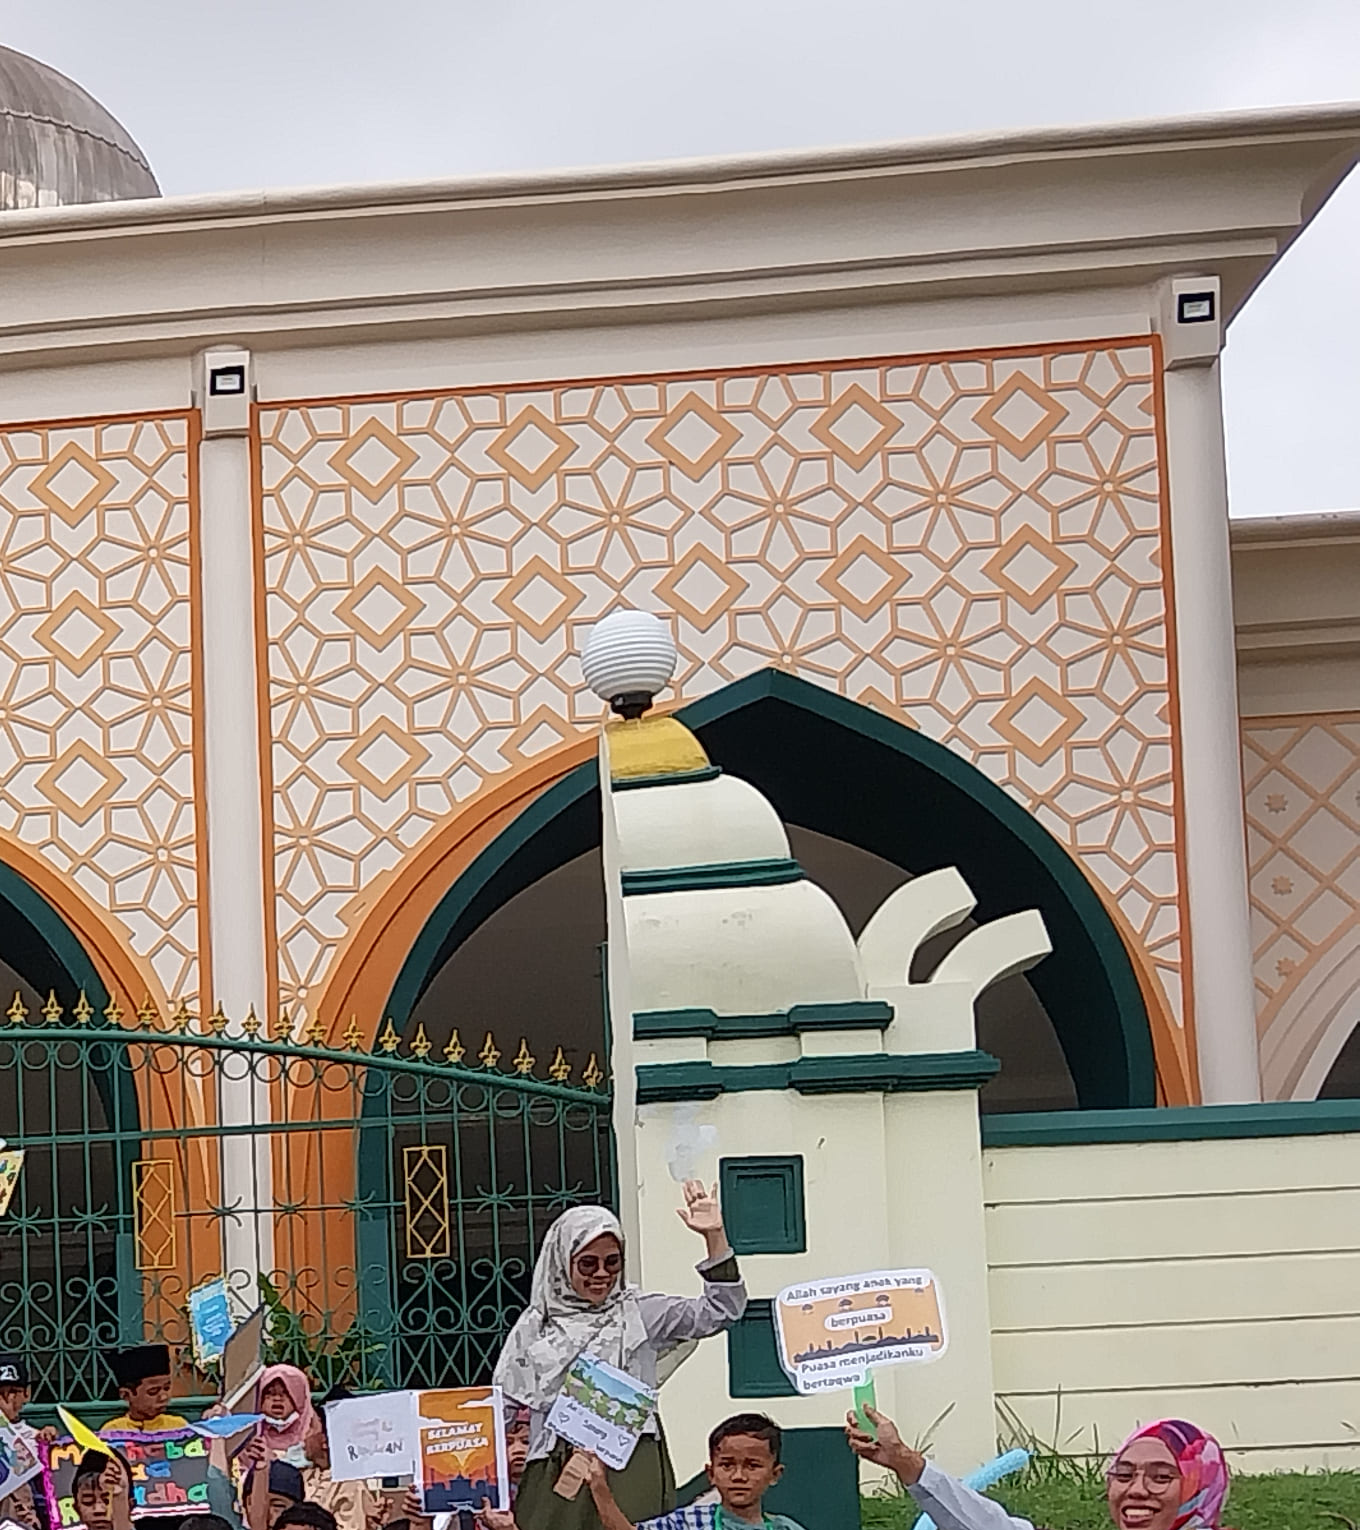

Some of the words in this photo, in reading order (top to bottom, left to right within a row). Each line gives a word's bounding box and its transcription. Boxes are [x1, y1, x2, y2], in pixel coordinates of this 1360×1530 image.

[786, 1288, 817, 1301] Allah
[820, 1282, 861, 1297] sayang
[895, 1275, 923, 1288] yang
[830, 1311, 887, 1329] berpuasa
[801, 1360, 837, 1374] Puasa
[802, 1374, 861, 1391] bertaqwa
